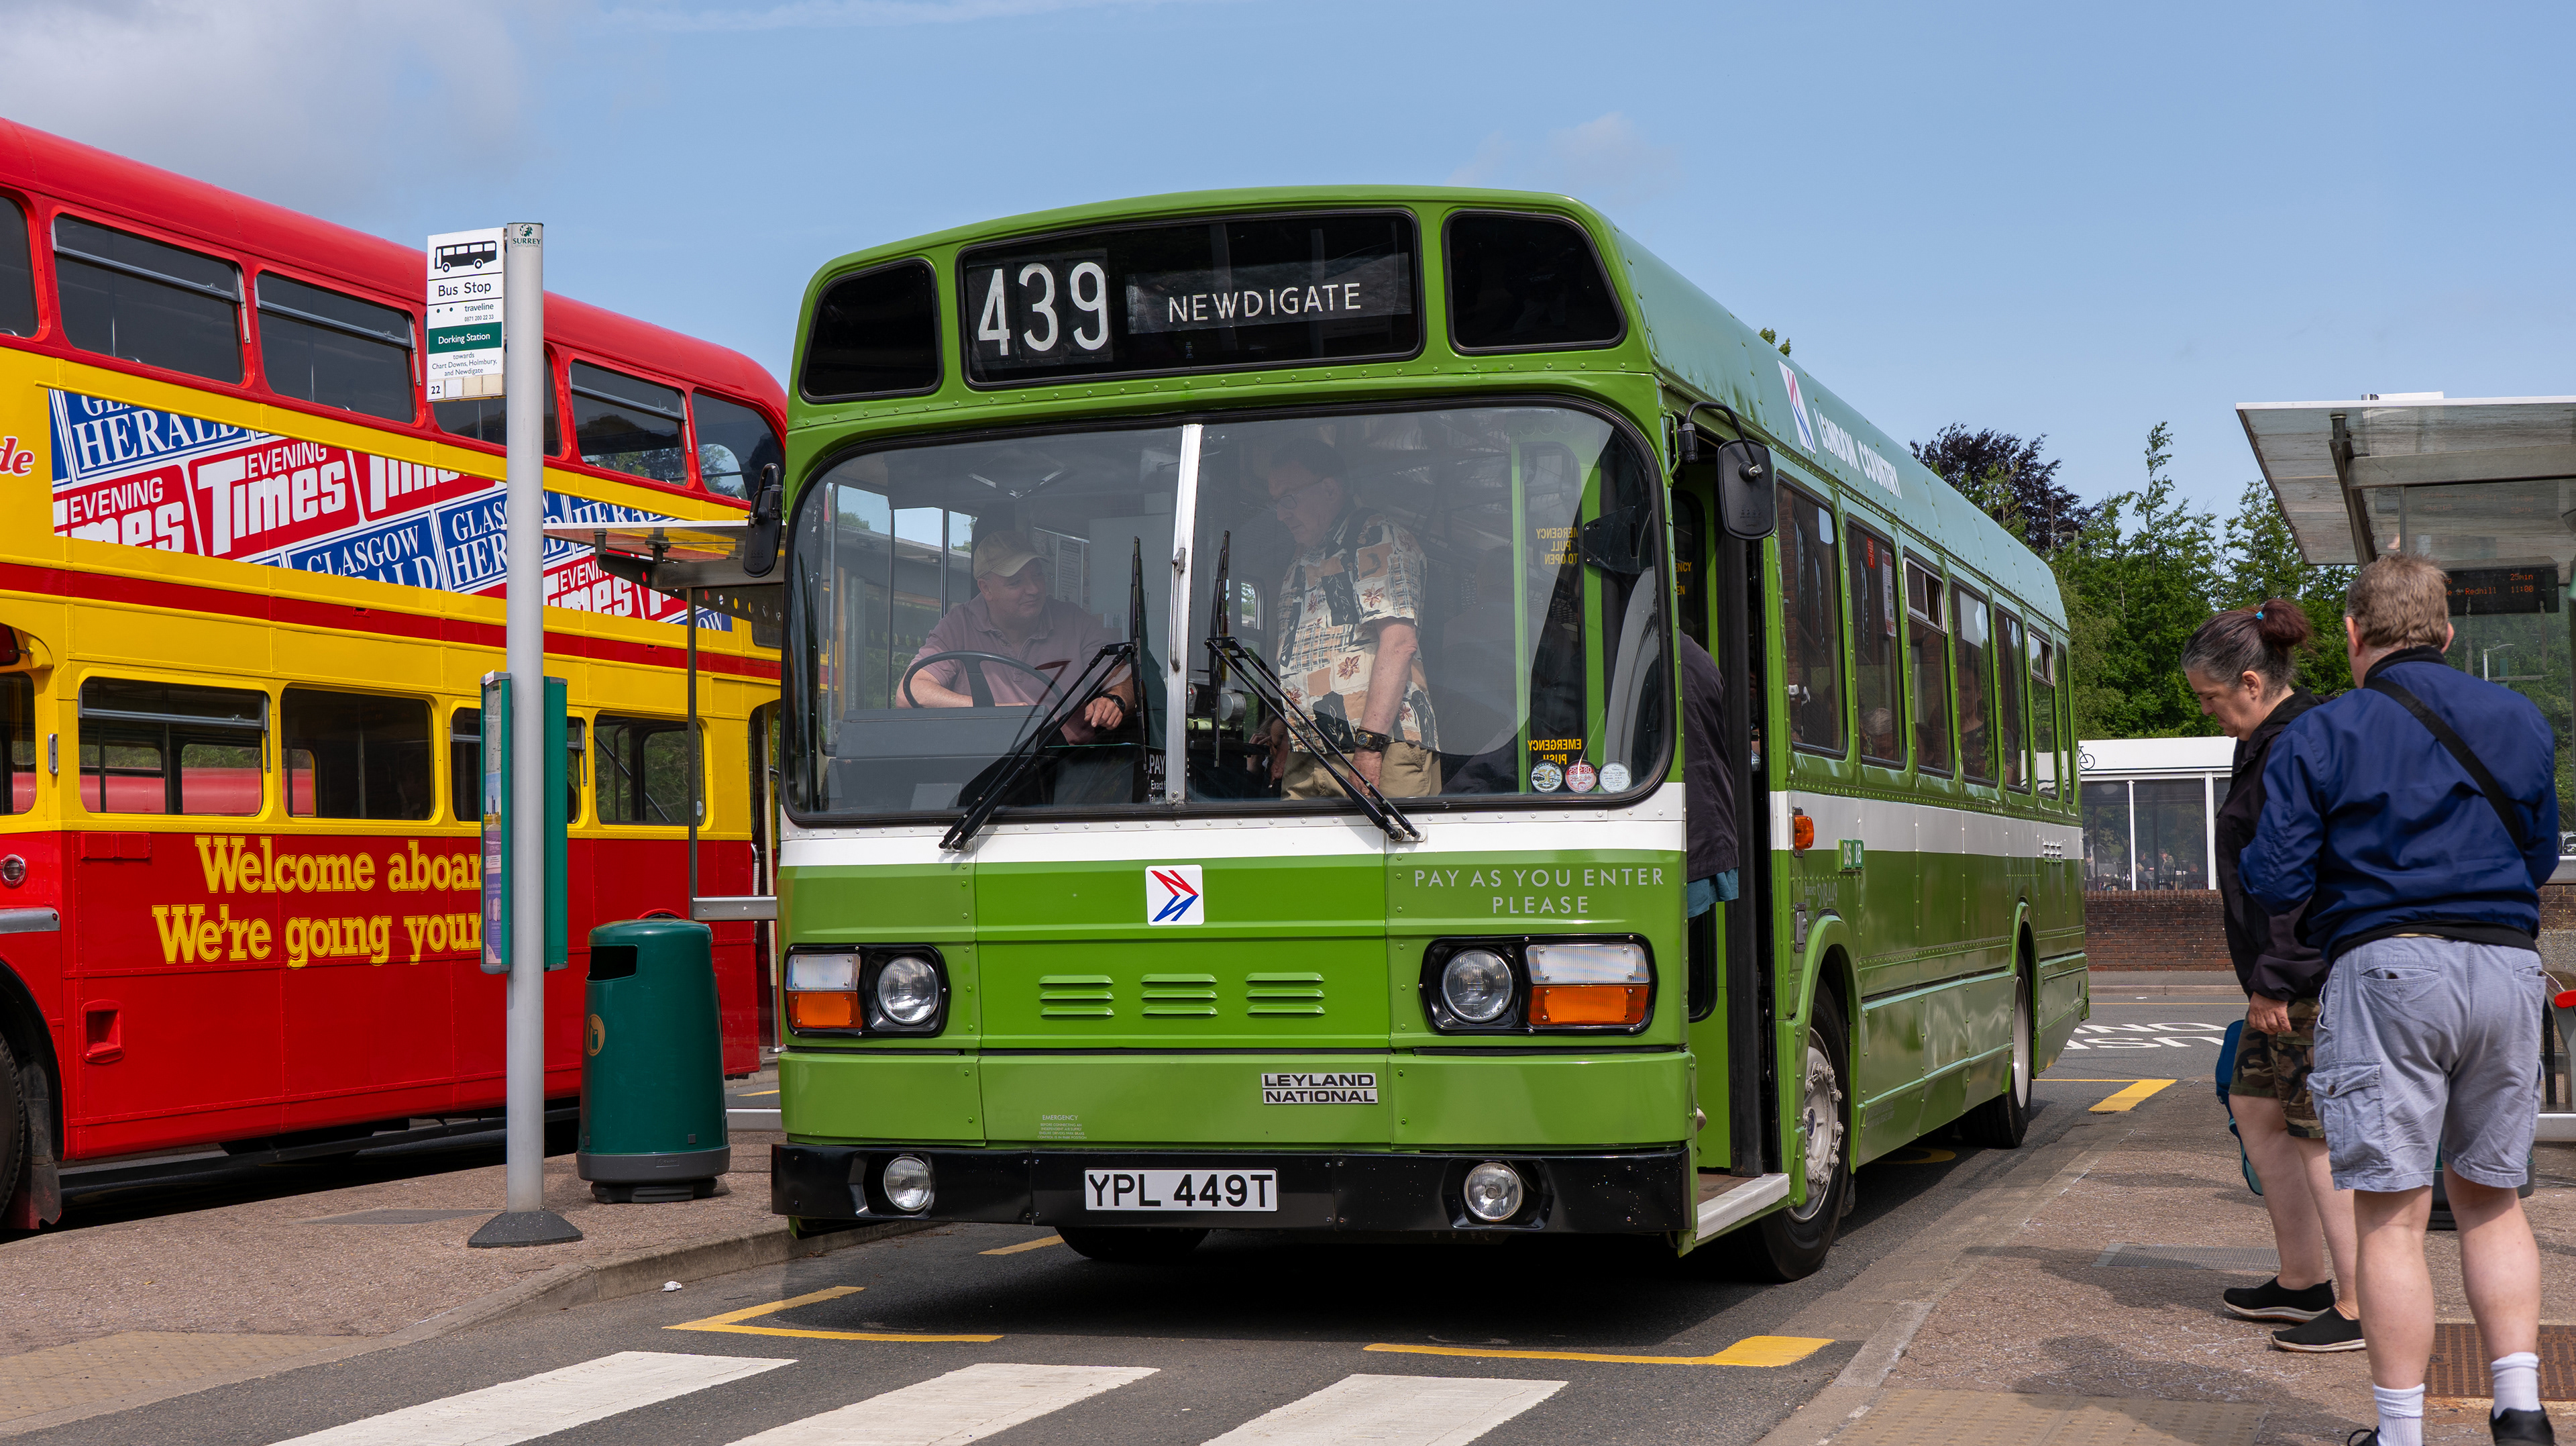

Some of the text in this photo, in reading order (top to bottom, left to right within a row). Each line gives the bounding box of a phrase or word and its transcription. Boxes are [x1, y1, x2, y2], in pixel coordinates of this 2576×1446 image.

[438, 282, 492, 297] Bus Stop
[464, 303, 494, 312] traveline
[978, 262, 1110, 356] 439
[1168, 282, 1362, 323] NEWDIGATE
[438, 333, 490, 345] Dorking Station
[453, 352, 475, 360] towards
[468, 358, 498, 366] Holmbury,
[455, 368, 484, 376] Newdigate
[431, 385, 441, 395] 22
[0, 435, 36, 477] de
[248, 442, 327, 478] EVENING
[1813, 407, 1902, 500] LONDON COUNTRY
[70, 476, 163, 523] EVENING
[197, 456, 346, 556] Times
[307, 525, 419, 576] GLASGOW
[560, 560, 610, 592] EVENI
[2510, 573, 2534, 581] 25min
[1677, 585, 1686, 595] EN
[2465, 586, 2497, 595] Redhill
[2511, 585, 2534, 593] 11:00
[1149, 754, 1166, 774] PAY
[1843, 842, 1862, 866] DS 18
[195, 835, 481, 893] Welcome aboar
[1415, 868, 1664, 887] PAY AS YOU ENTER
[1493, 896, 1589, 914] PLEASE
[152, 904, 272, 964] We're
[286, 915, 393, 970] going
[1264, 1074, 1375, 1086] LEYLAND
[1265, 1090, 1375, 1102] NATIONAL
[1088, 1174, 1273, 1208] YPL 449T
